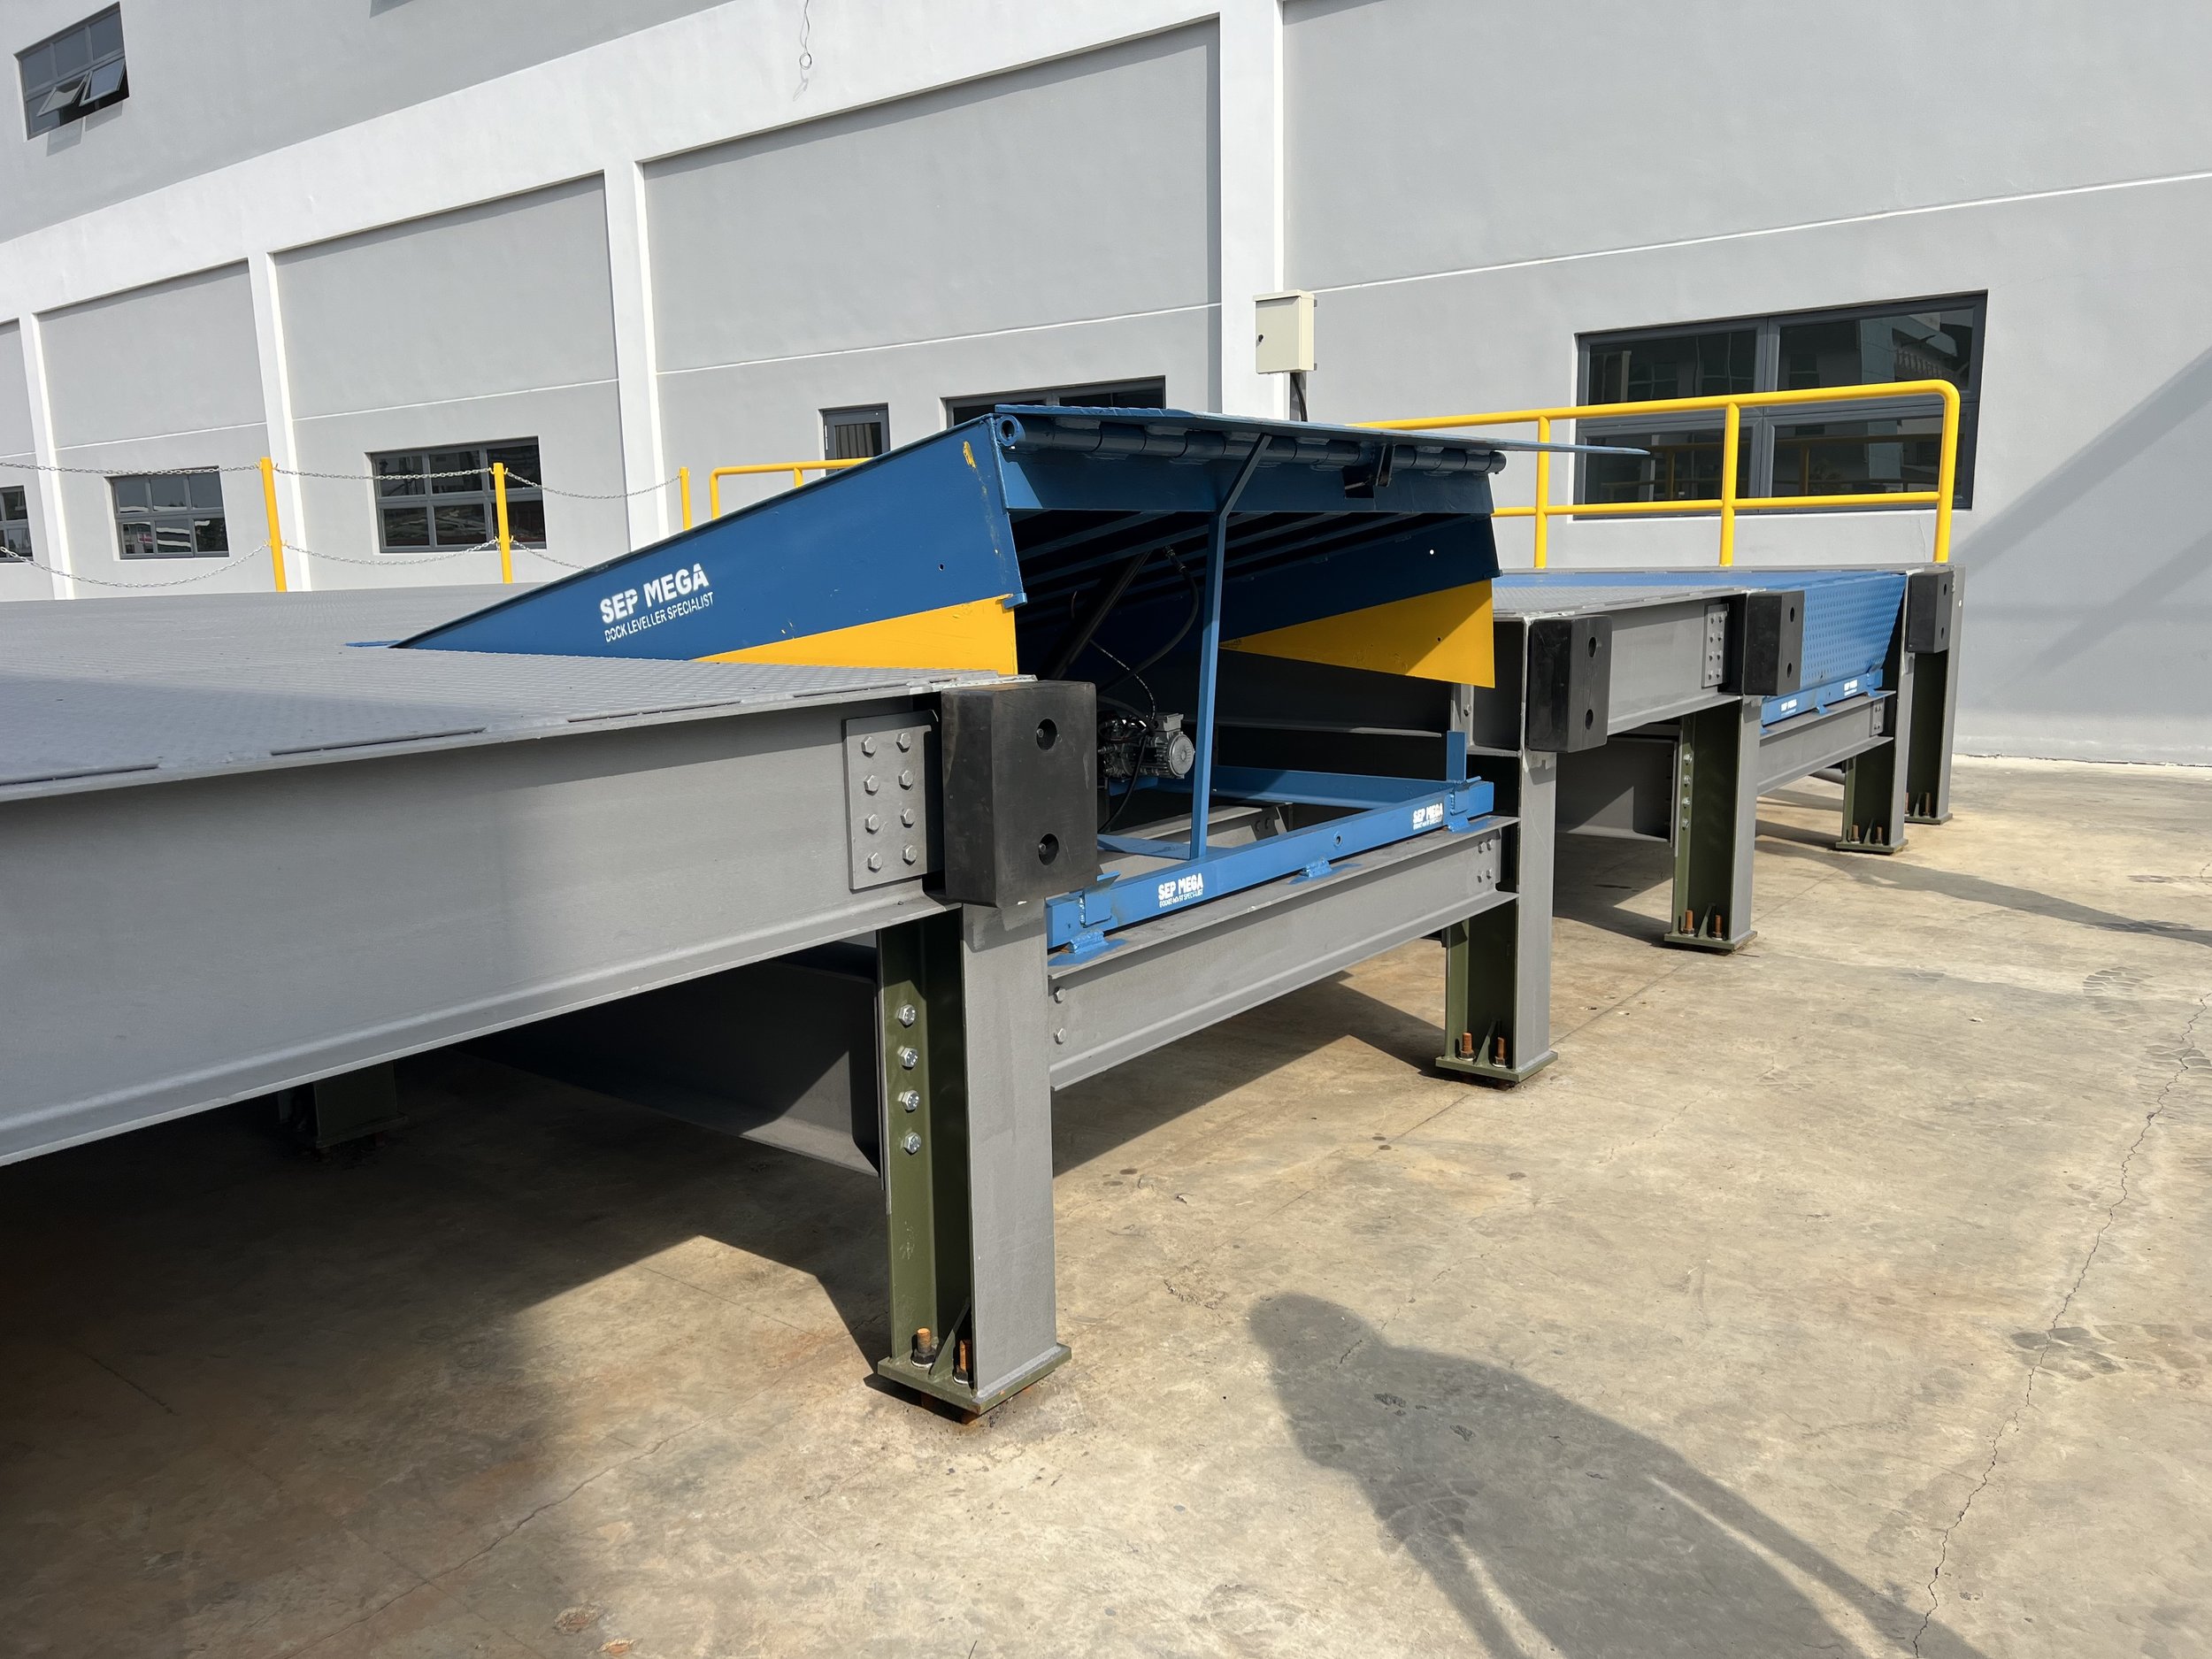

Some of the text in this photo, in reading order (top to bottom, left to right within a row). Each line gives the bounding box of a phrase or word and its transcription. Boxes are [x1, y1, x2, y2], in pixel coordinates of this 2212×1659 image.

[600, 564, 709, 624] SEP MEGA
[604, 592, 713, 642] DOCK LEVELLER SPECIALIST
[1158, 872, 1203, 900] SEP MEGA
